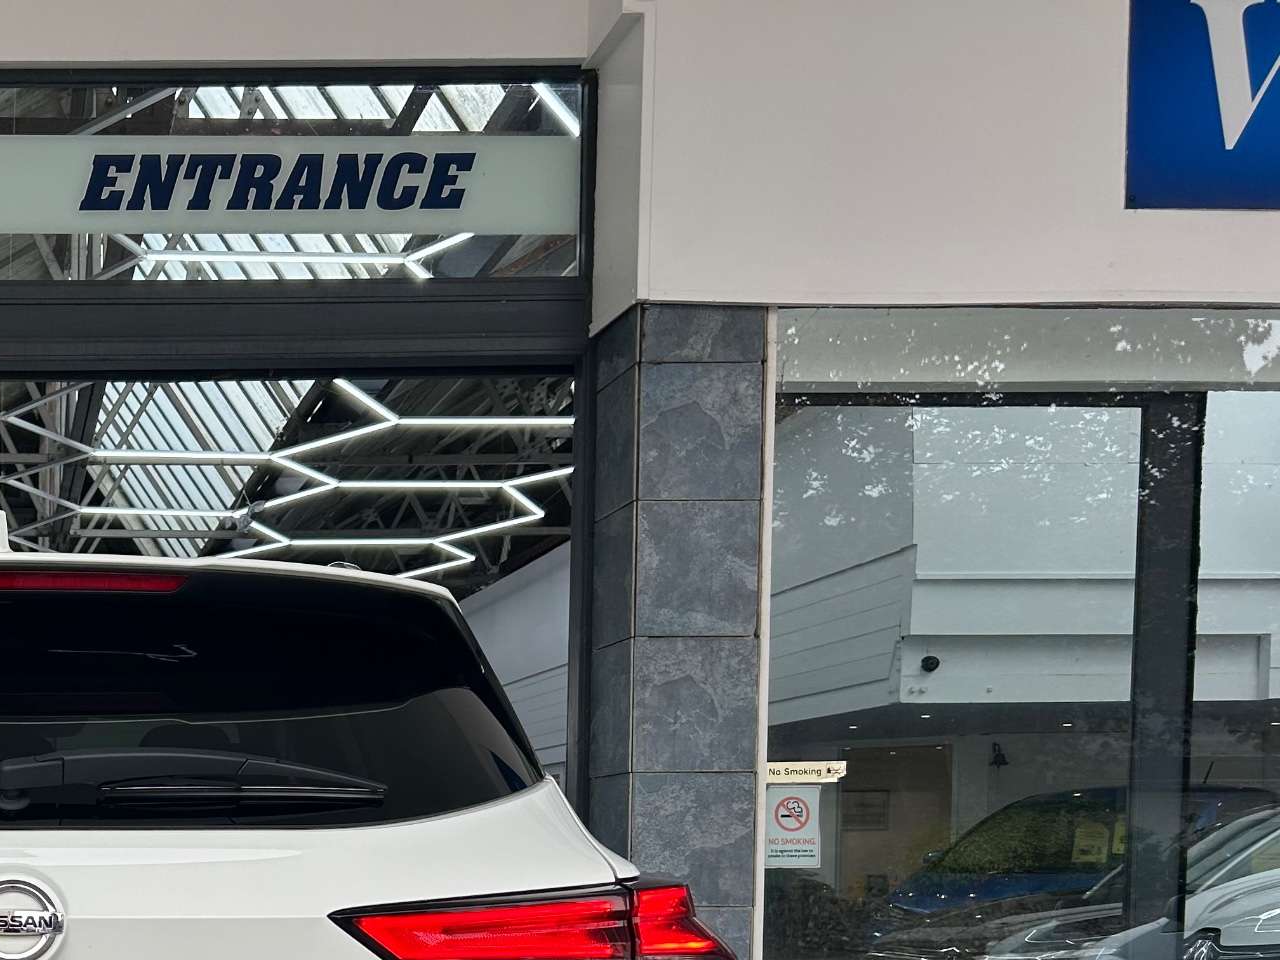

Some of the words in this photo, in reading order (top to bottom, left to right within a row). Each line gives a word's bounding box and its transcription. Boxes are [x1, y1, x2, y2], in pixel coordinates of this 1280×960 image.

[78, 151, 477, 213] ENTRANCE
[768, 768, 781, 776] No
[784, 767, 822, 777] Smoking
